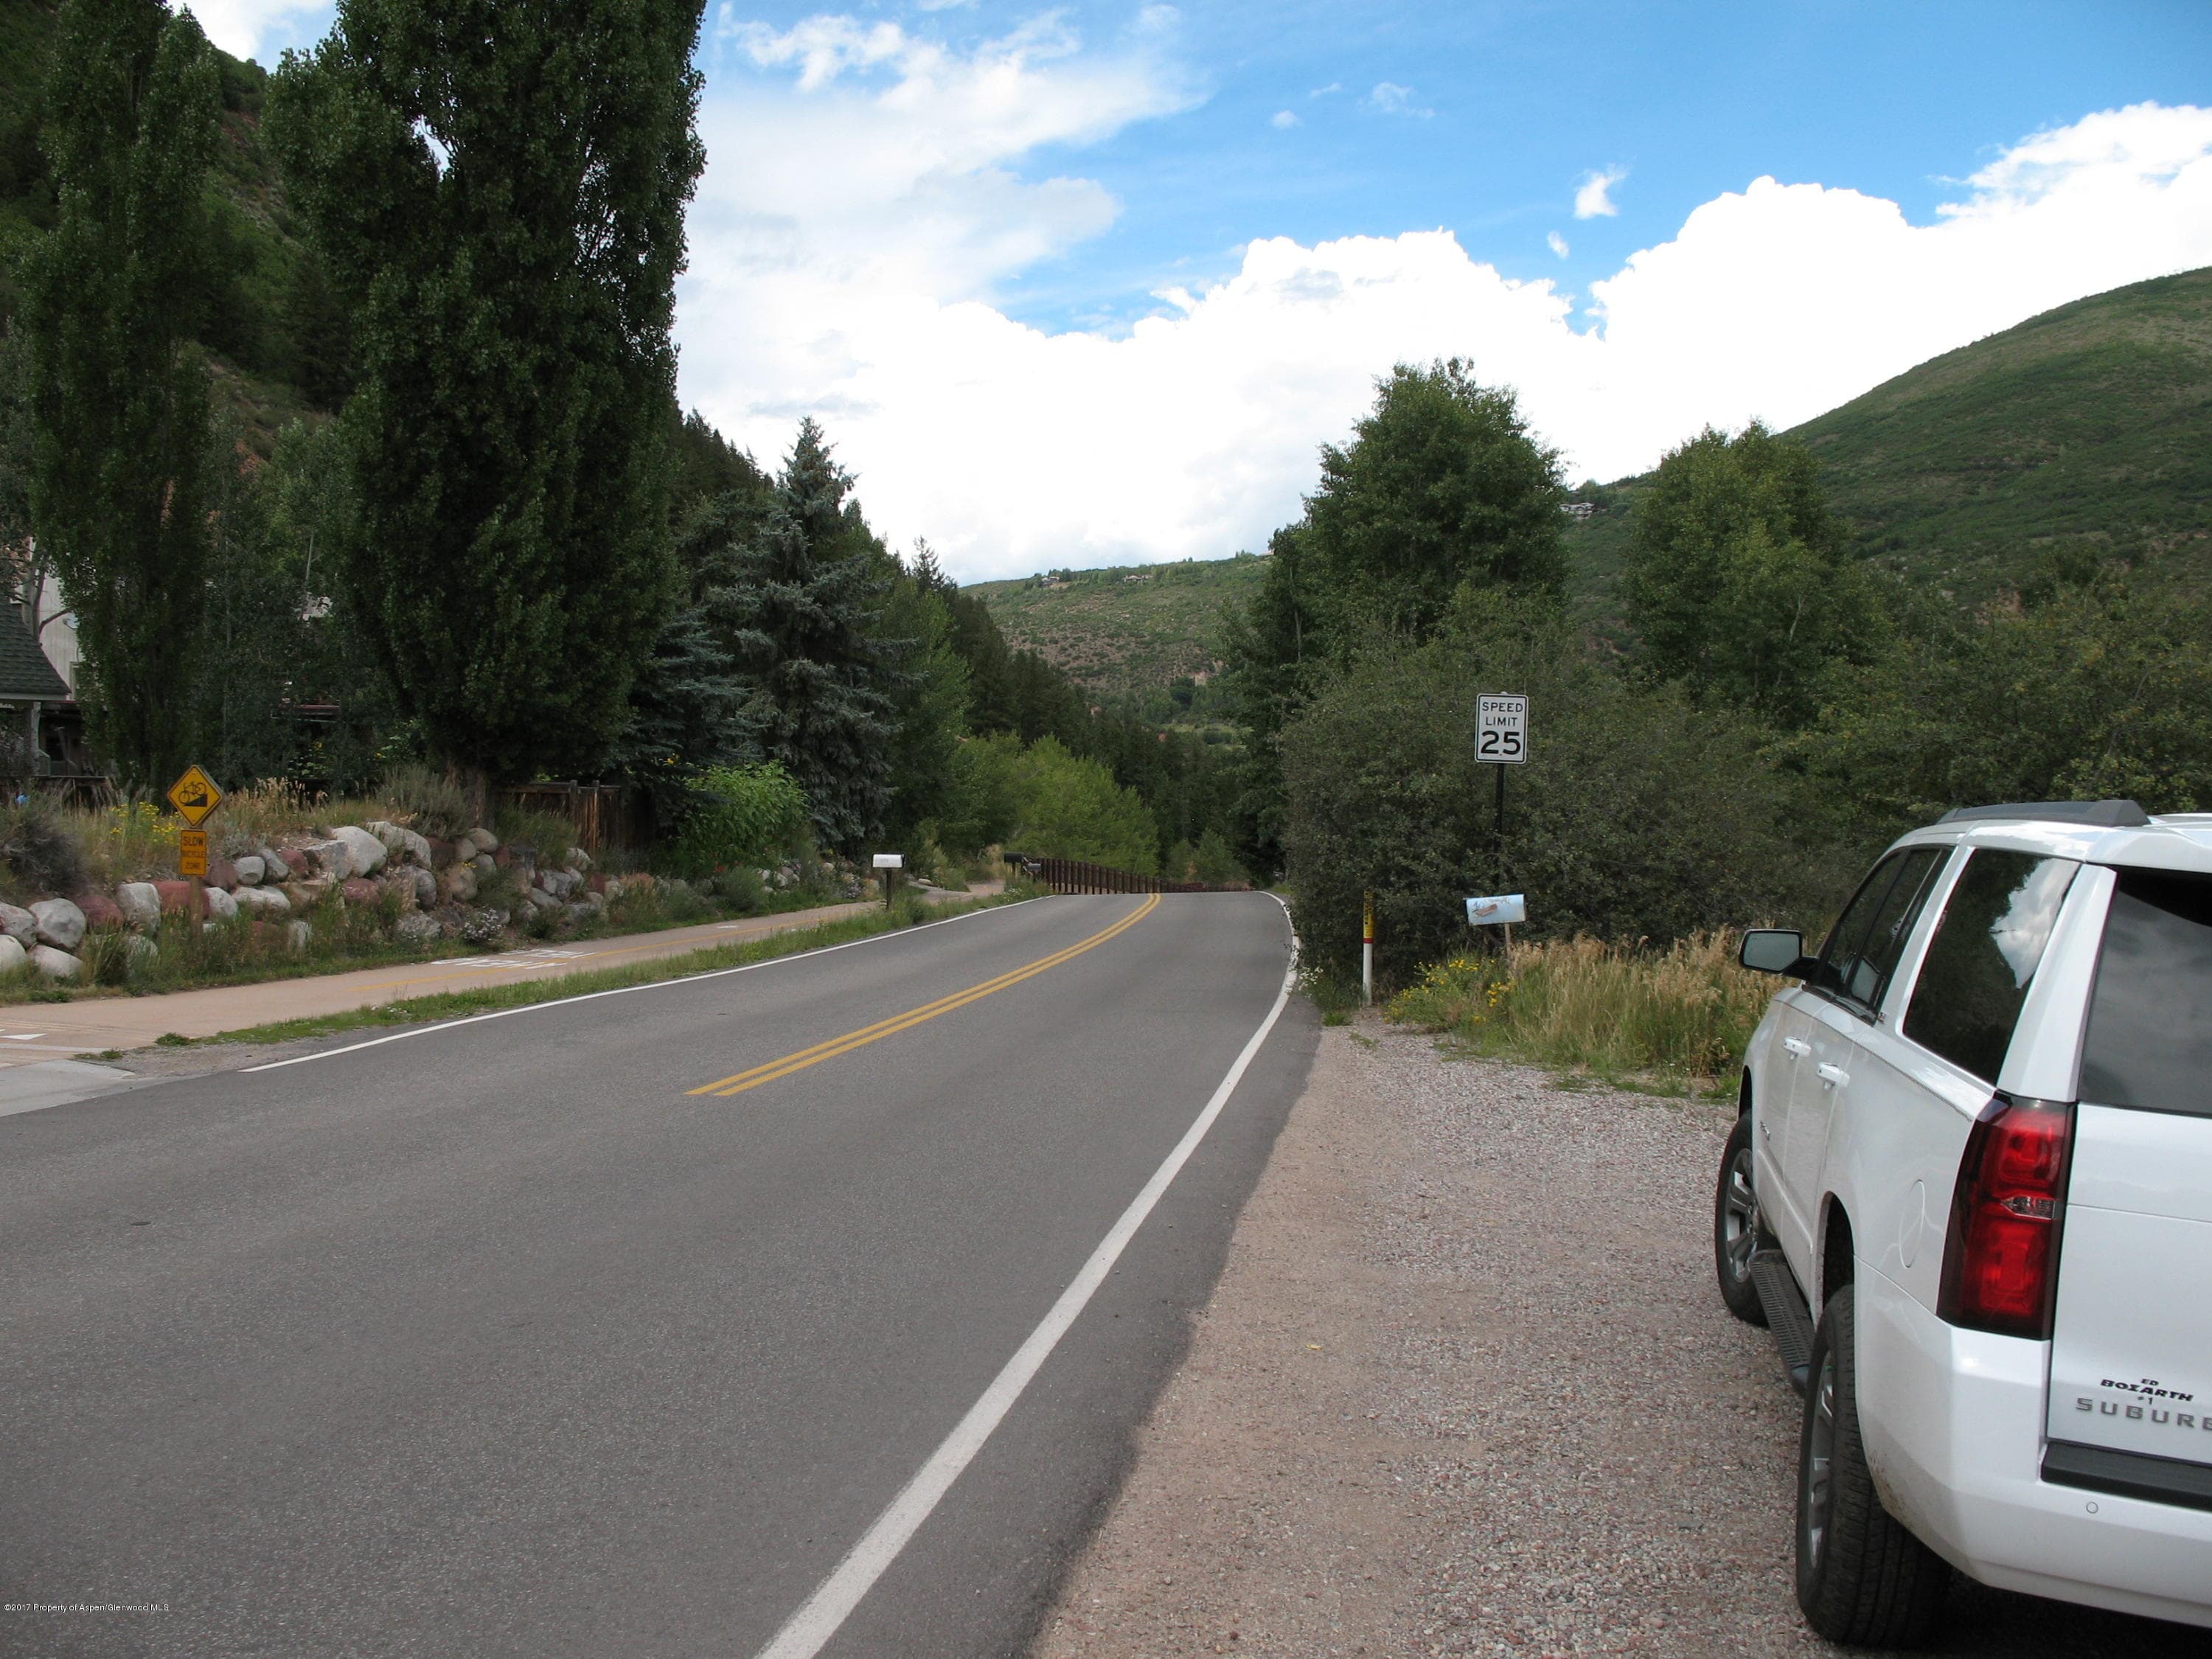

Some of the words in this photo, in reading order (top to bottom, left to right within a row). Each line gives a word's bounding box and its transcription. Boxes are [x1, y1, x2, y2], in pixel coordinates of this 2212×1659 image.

[1481, 701, 1523, 713] SPEED
[1485, 716, 1518, 727] LIMIT
[1480, 730, 1521, 756] 25
[184, 835, 204, 846] SLOW
[2140, 1378, 2160, 1386] ED
